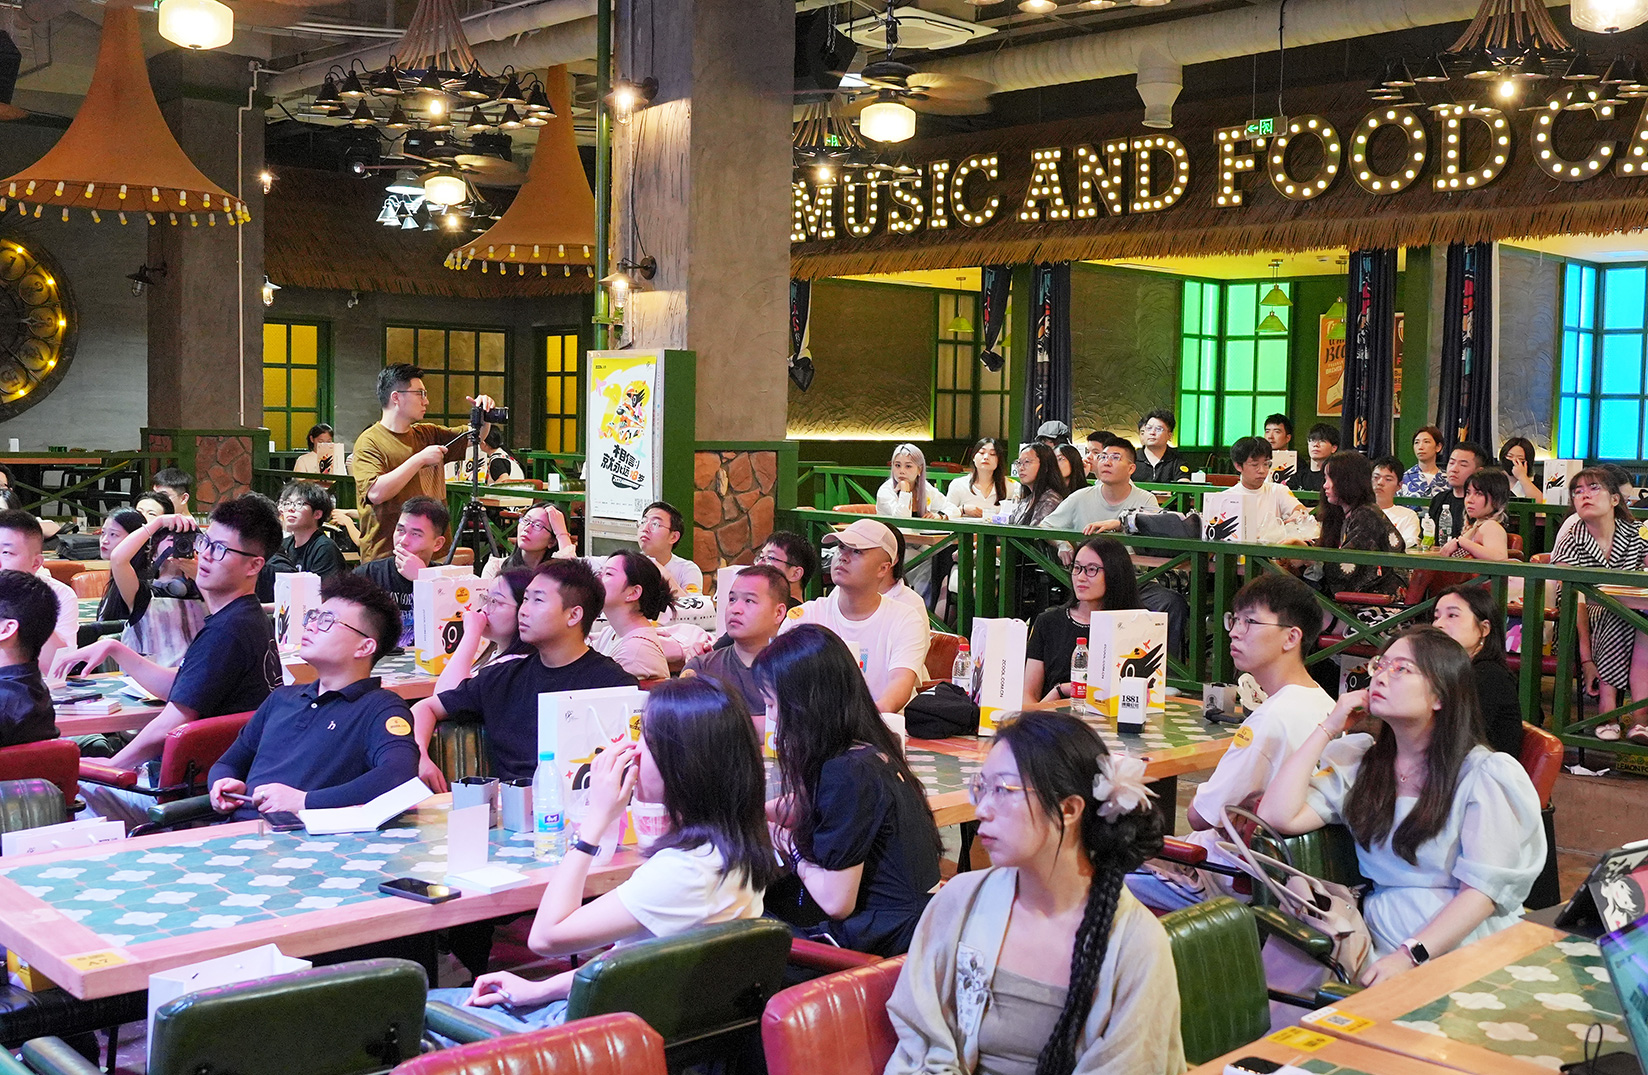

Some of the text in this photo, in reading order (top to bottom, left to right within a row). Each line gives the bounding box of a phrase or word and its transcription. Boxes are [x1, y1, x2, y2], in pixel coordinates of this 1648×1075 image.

[791, 151, 999, 243] MUSIC
[1015, 132, 1190, 226] AND
[1212, 104, 1512, 208] FOOD
[1121, 694, 1140, 702] 1881
